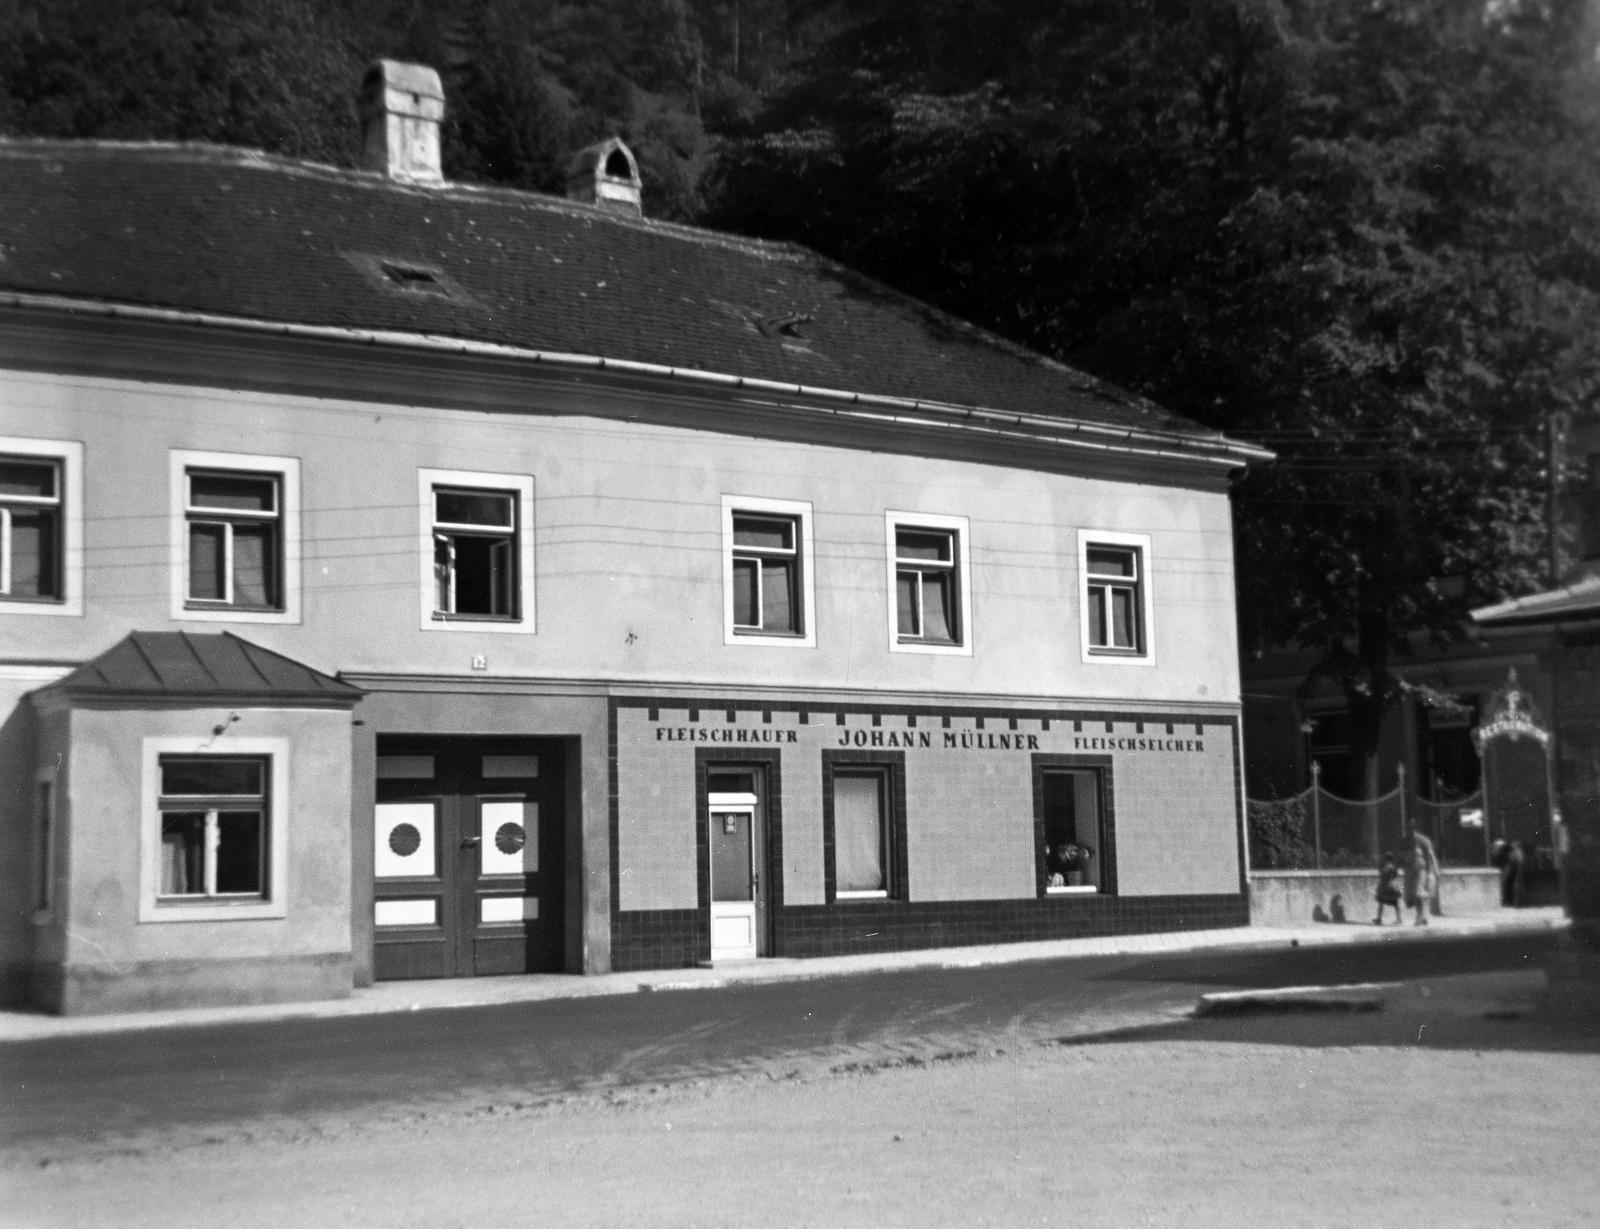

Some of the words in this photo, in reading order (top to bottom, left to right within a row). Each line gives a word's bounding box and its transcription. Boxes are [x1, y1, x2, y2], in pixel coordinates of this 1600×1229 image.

[656, 727, 798, 744] FLEISCHHAUER
[838, 729, 931, 748] JOHANN
[943, 729, 1041, 750] MÜLLNER
[1074, 737, 1205, 753] FLEISCHSELCHER
